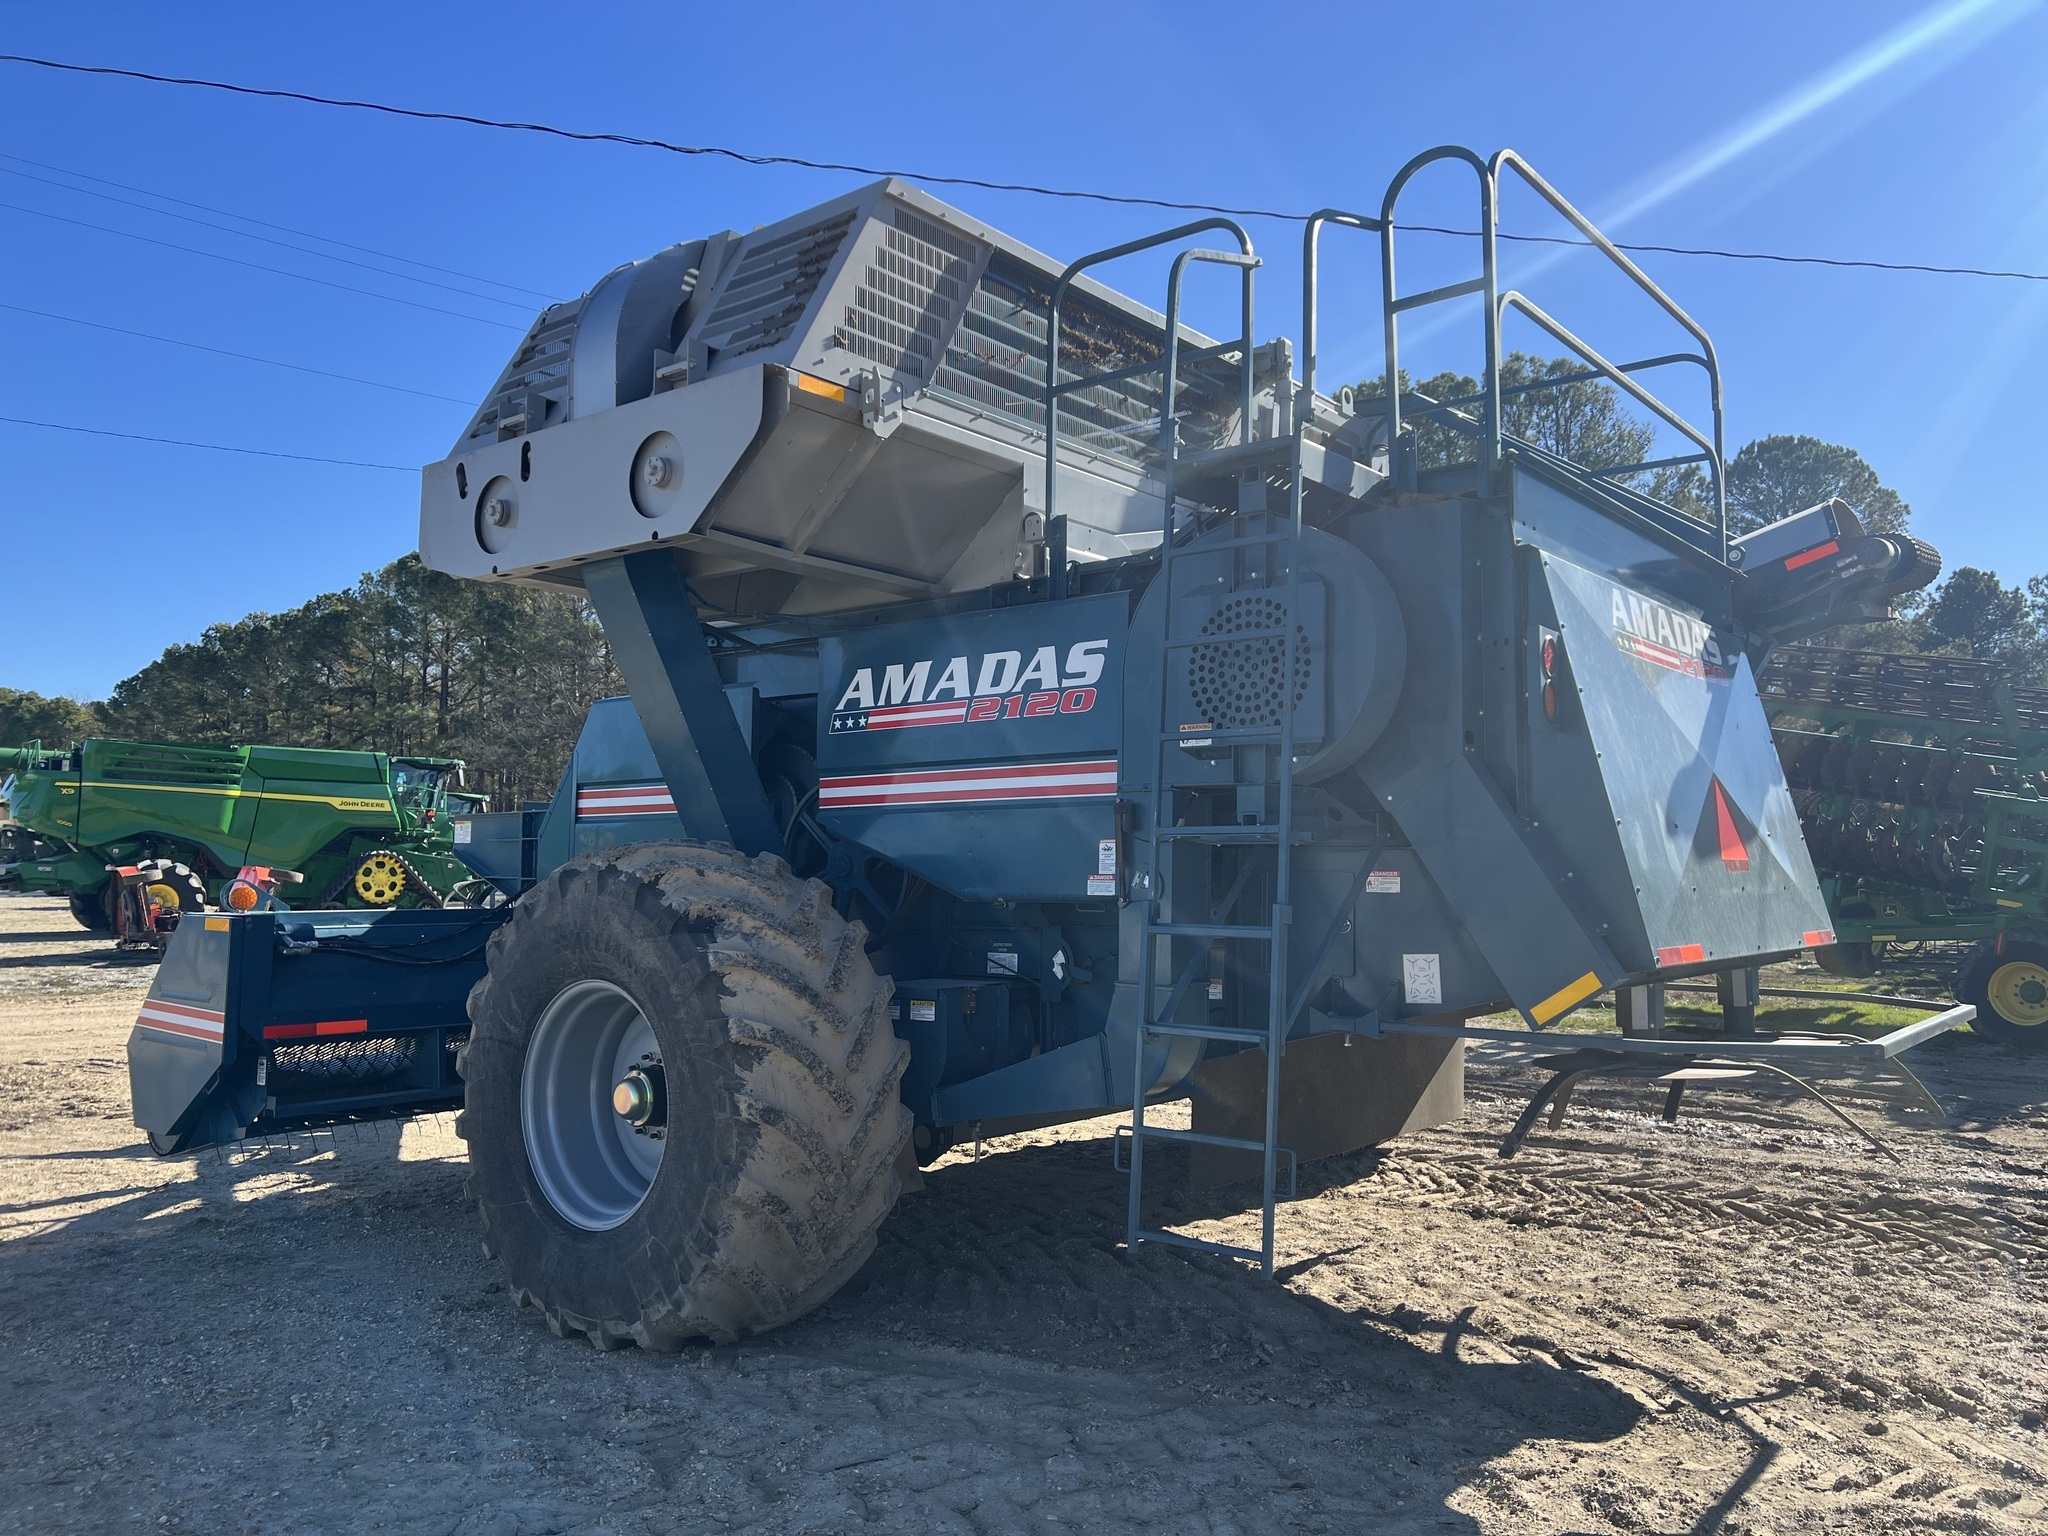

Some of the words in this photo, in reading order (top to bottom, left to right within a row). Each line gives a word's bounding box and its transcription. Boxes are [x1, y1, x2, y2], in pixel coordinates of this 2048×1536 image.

[1612, 587, 1723, 666] AMADAS
[835, 639, 1109, 711] AMADAS
[1680, 652, 1729, 687] 2120
[967, 687, 1098, 723] 2120
[1186, 723, 1211, 731] WARNING
[60, 787, 75, 795] X9
